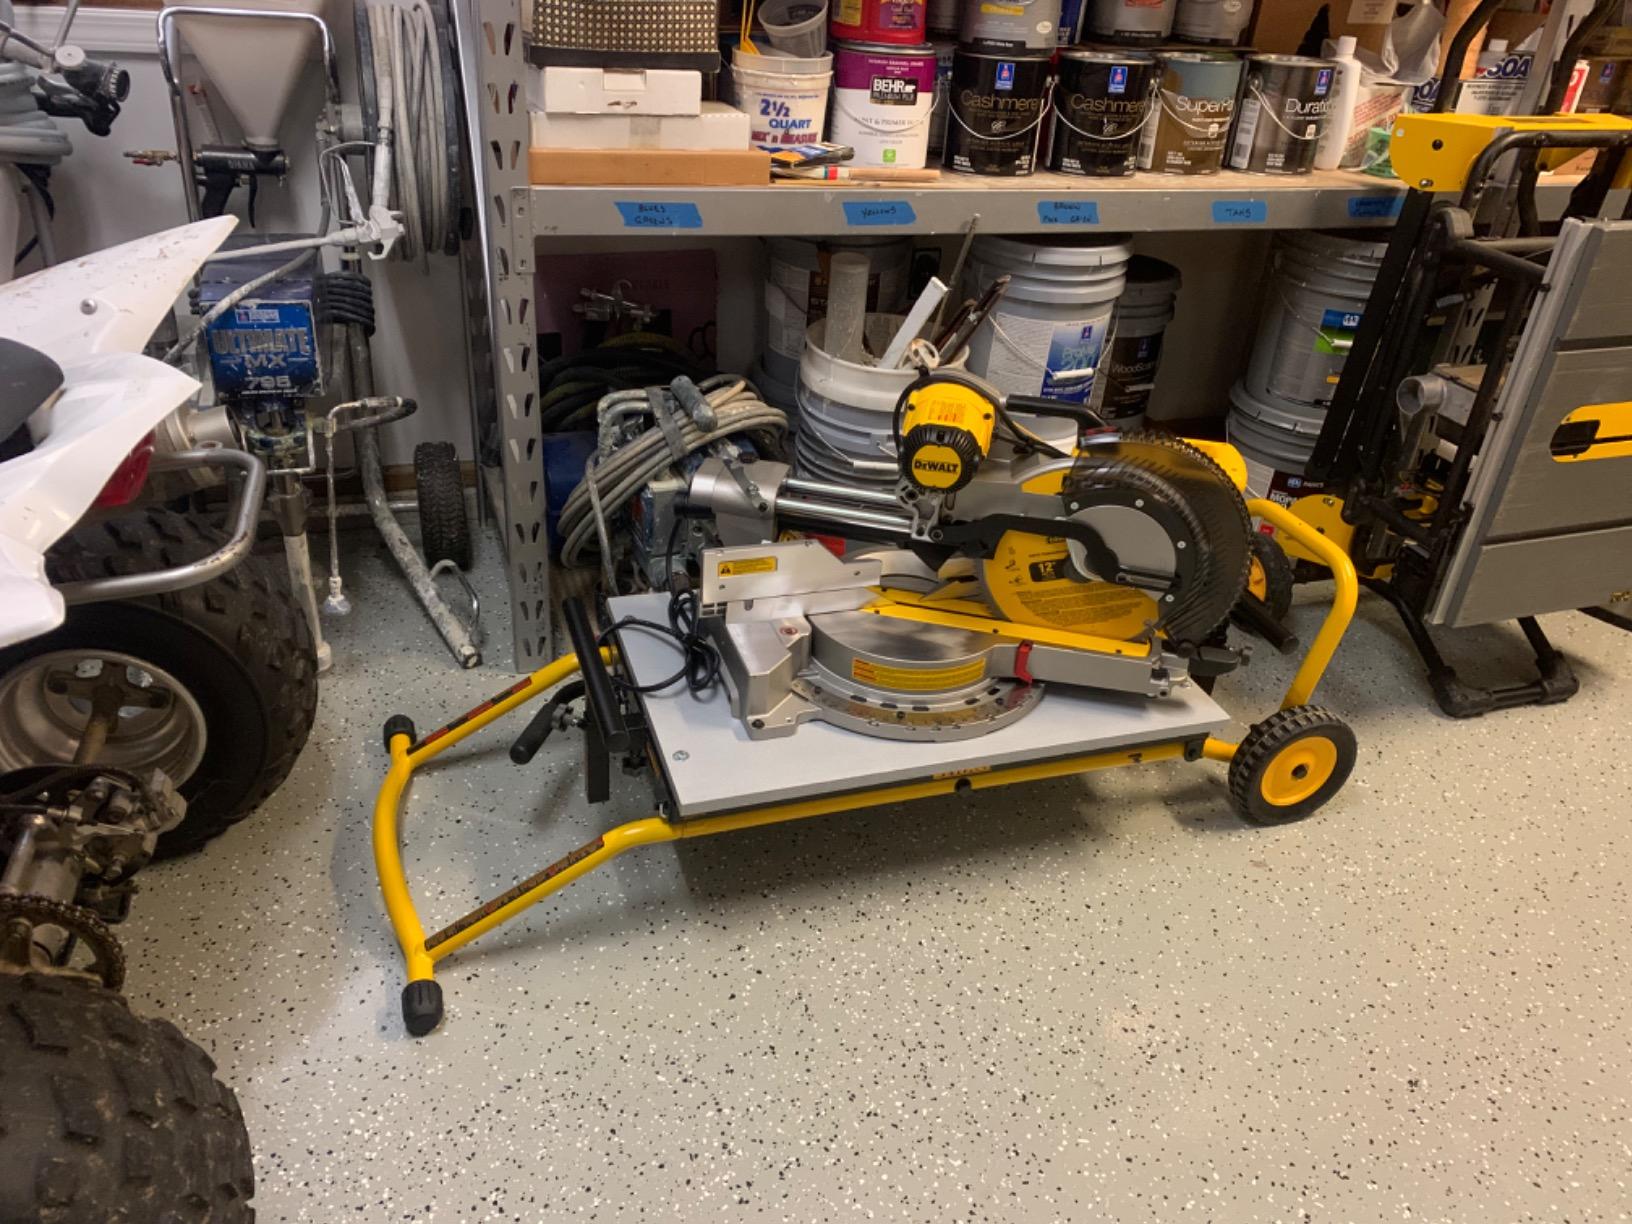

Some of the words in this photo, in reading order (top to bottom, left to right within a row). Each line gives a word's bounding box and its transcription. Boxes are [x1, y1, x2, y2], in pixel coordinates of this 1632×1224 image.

[872, 78, 906, 93] BEHR
[768, 119, 813, 129] QUART
[1226, 207, 1252, 218] TANS
[211, 327, 312, 355] ULTIMATE
[243, 354, 287, 369] MX
